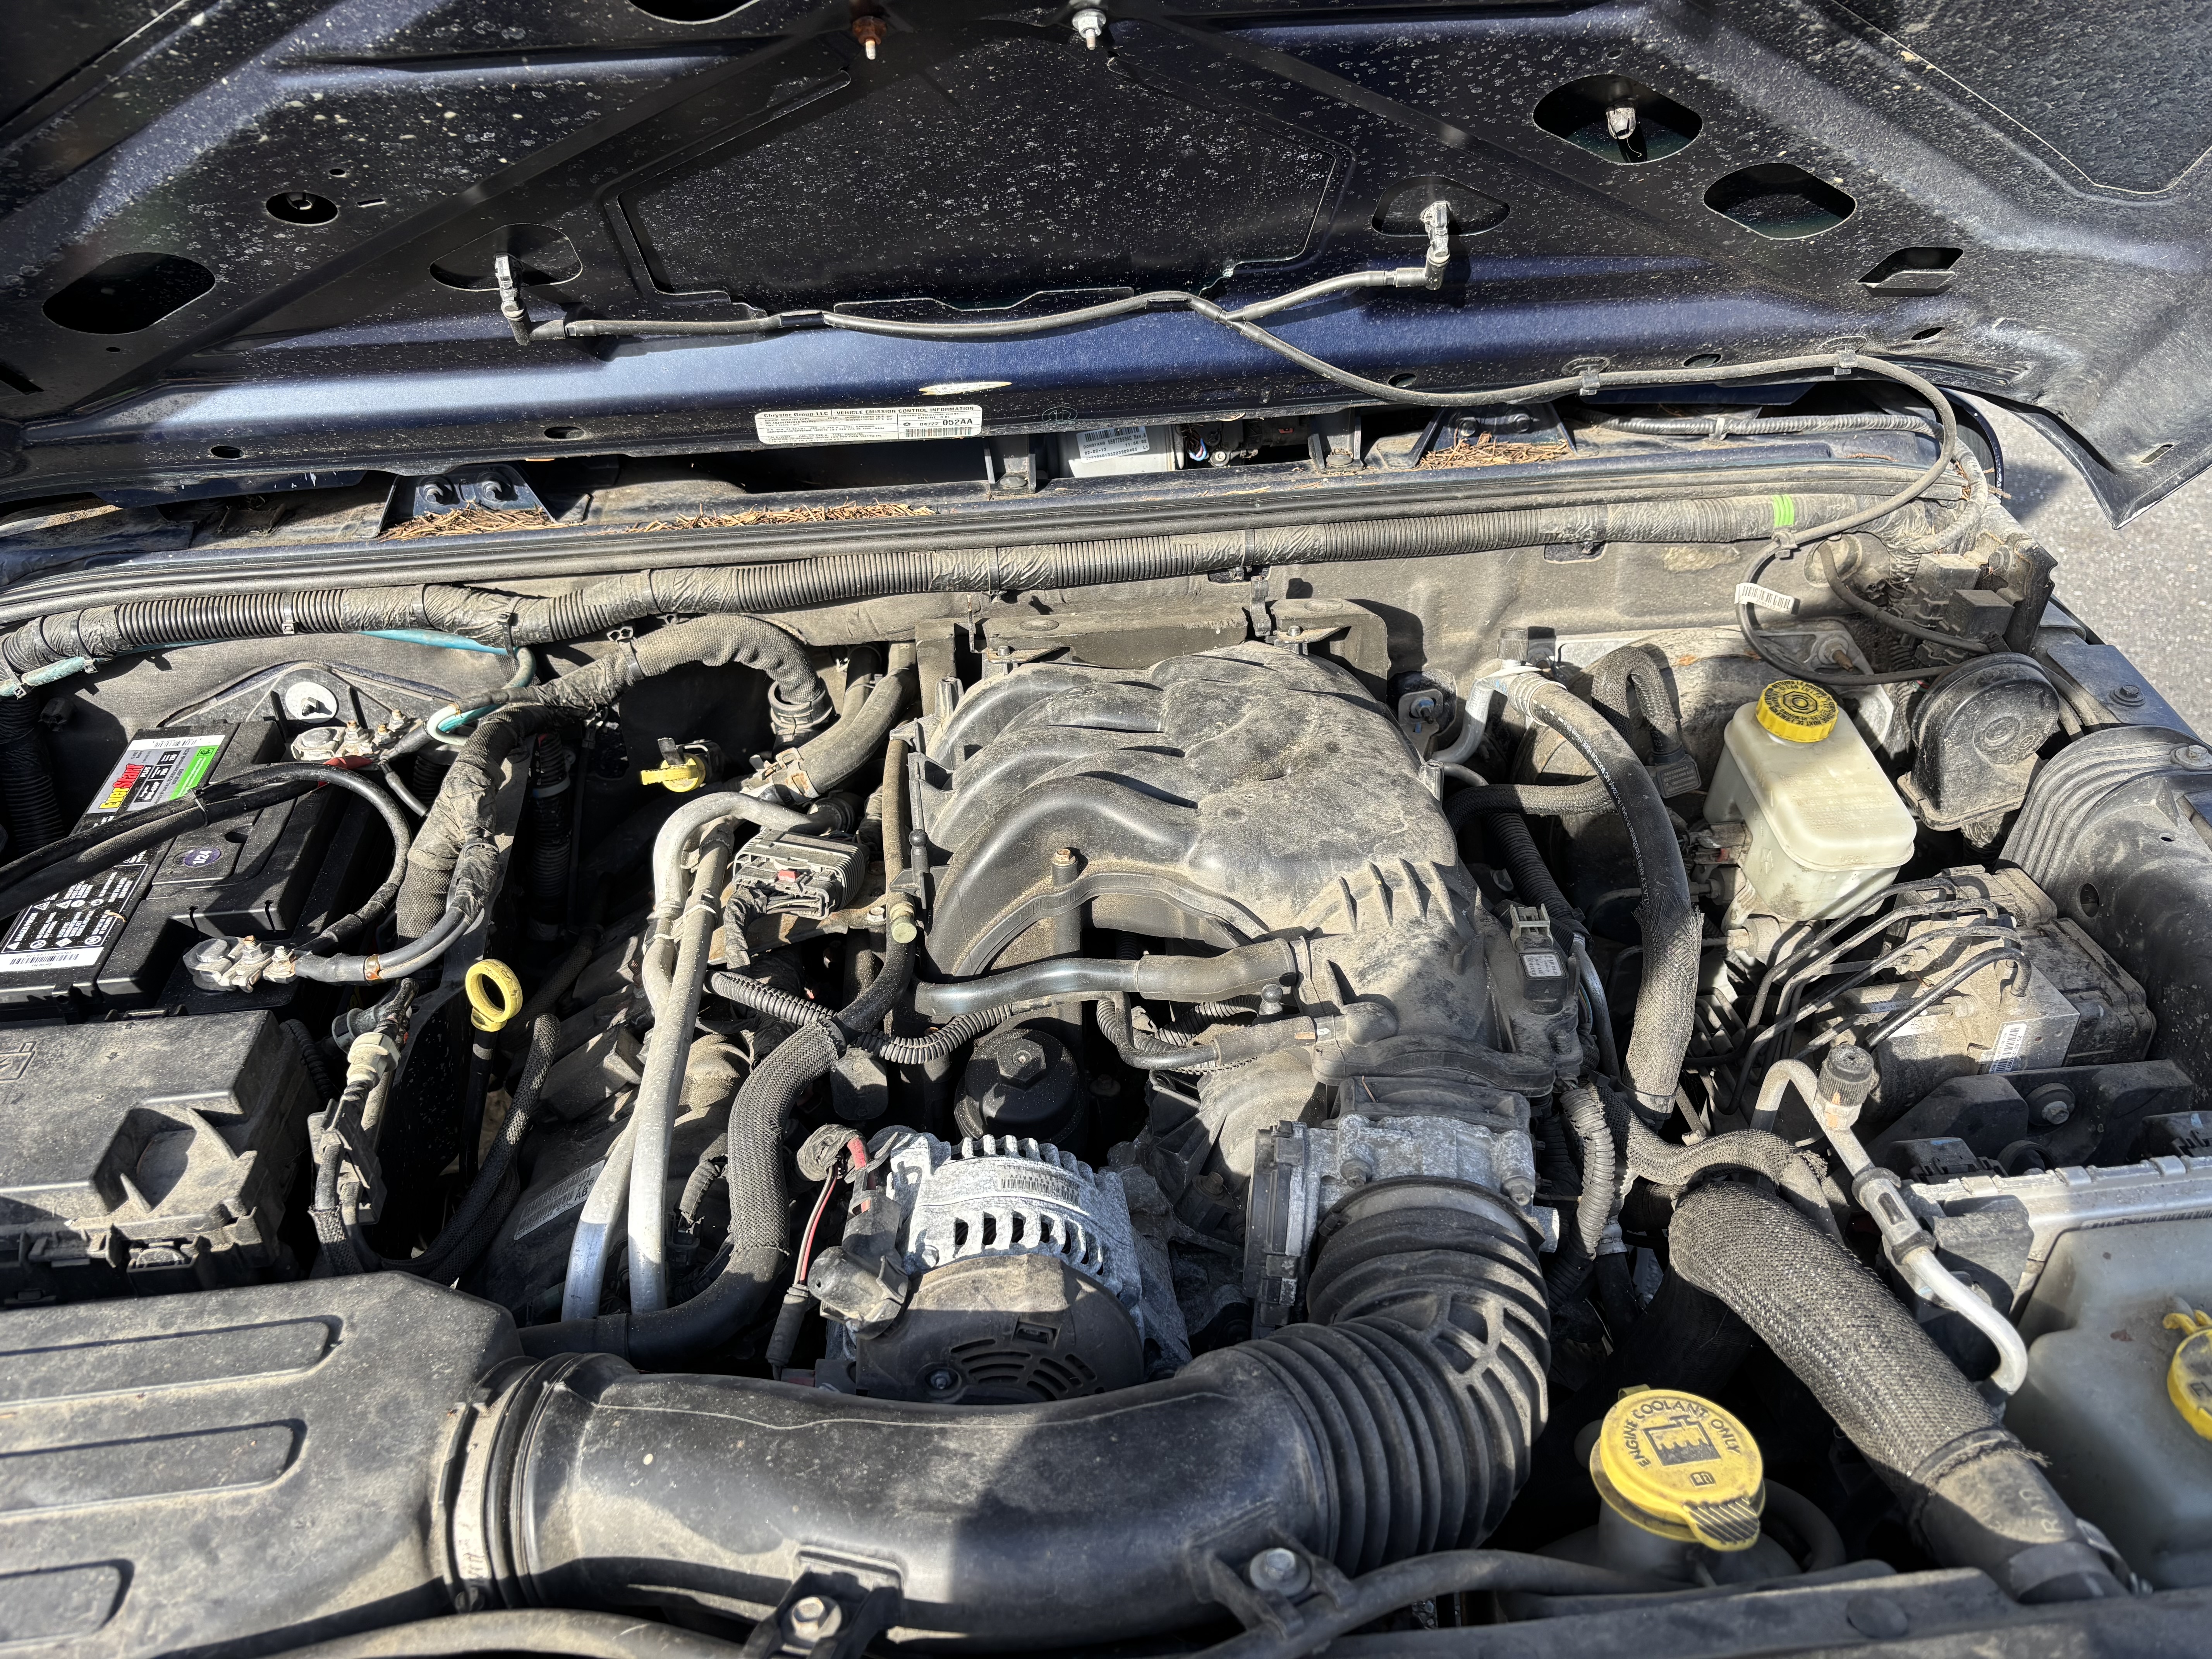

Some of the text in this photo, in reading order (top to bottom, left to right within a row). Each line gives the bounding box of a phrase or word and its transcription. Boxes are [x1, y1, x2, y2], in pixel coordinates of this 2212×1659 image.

[1582, 740, 1593, 755] HOSE
[139, 766, 153, 777] PLUS
[1590, 753, 1606, 774] SUCTION
[98, 763, 146, 809] EverStart
[1603, 771, 1612, 782] A/C
[1620, 805, 1632, 827] R-134a
[1628, 826, 1641, 859] FlexBarrier
[192, 848, 213, 867] 1/24
[574, 1187, 588, 1202] AB
[1623, 1400, 1741, 1469] ENGINE COOLANT ONLY
